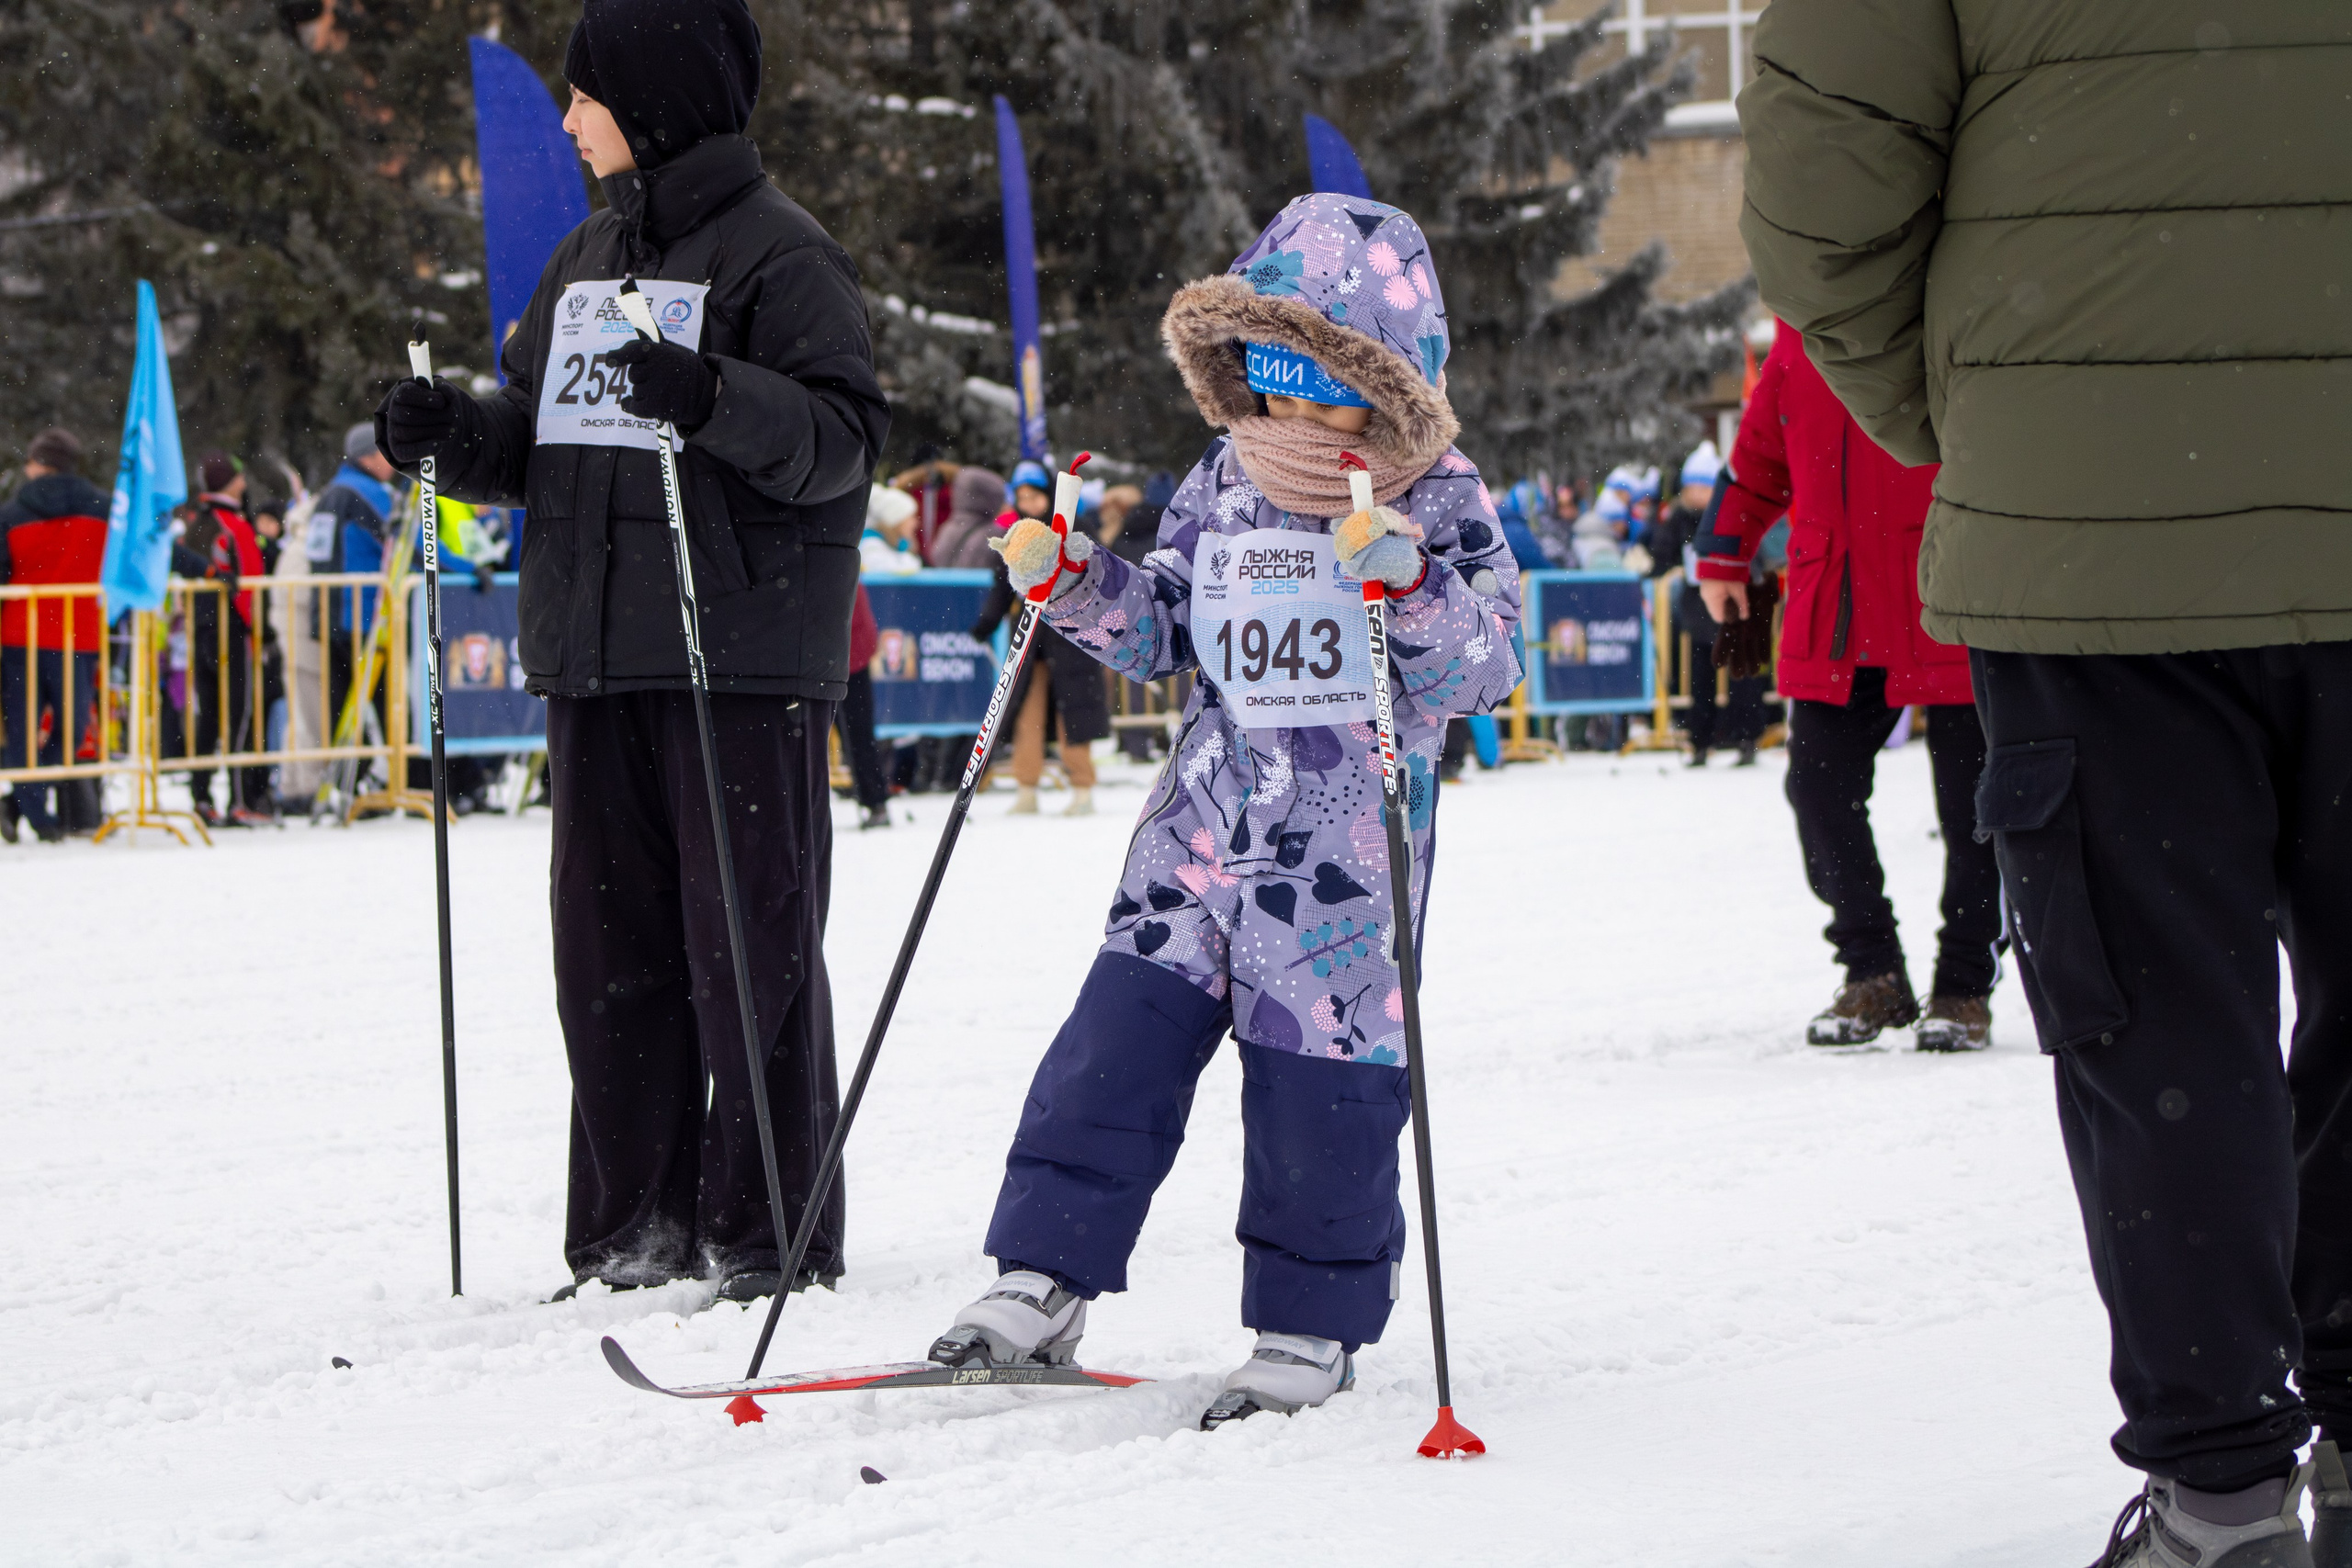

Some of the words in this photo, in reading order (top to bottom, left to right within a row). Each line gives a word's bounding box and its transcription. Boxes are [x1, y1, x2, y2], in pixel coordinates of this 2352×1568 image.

[600, 321, 636, 333] 2025
[581, 418, 615, 427] ОМСКАЯ
[617, 418, 656, 431] ОБЛАС
[659, 445, 677, 523] NORDWAY
[423, 487, 435, 566] NORDWAY
[1242, 548, 1316, 565] ЛЫЖНЯ
[1238, 565, 1317, 581] РОССИИ
[1250, 580, 1300, 595] 2025
[1216, 617, 1343, 682] 1943
[1246, 696, 1295, 707] ОМСКАЯ
[1302, 691, 1367, 706] ОБЛАСТЬ
[962, 668, 1011, 789] SPORTLIFE
[1374, 676, 1396, 793] SPORTLIFE
[952, 1369, 991, 1384] Larsen
[994, 1370, 1044, 1383] SPORTLIFE
